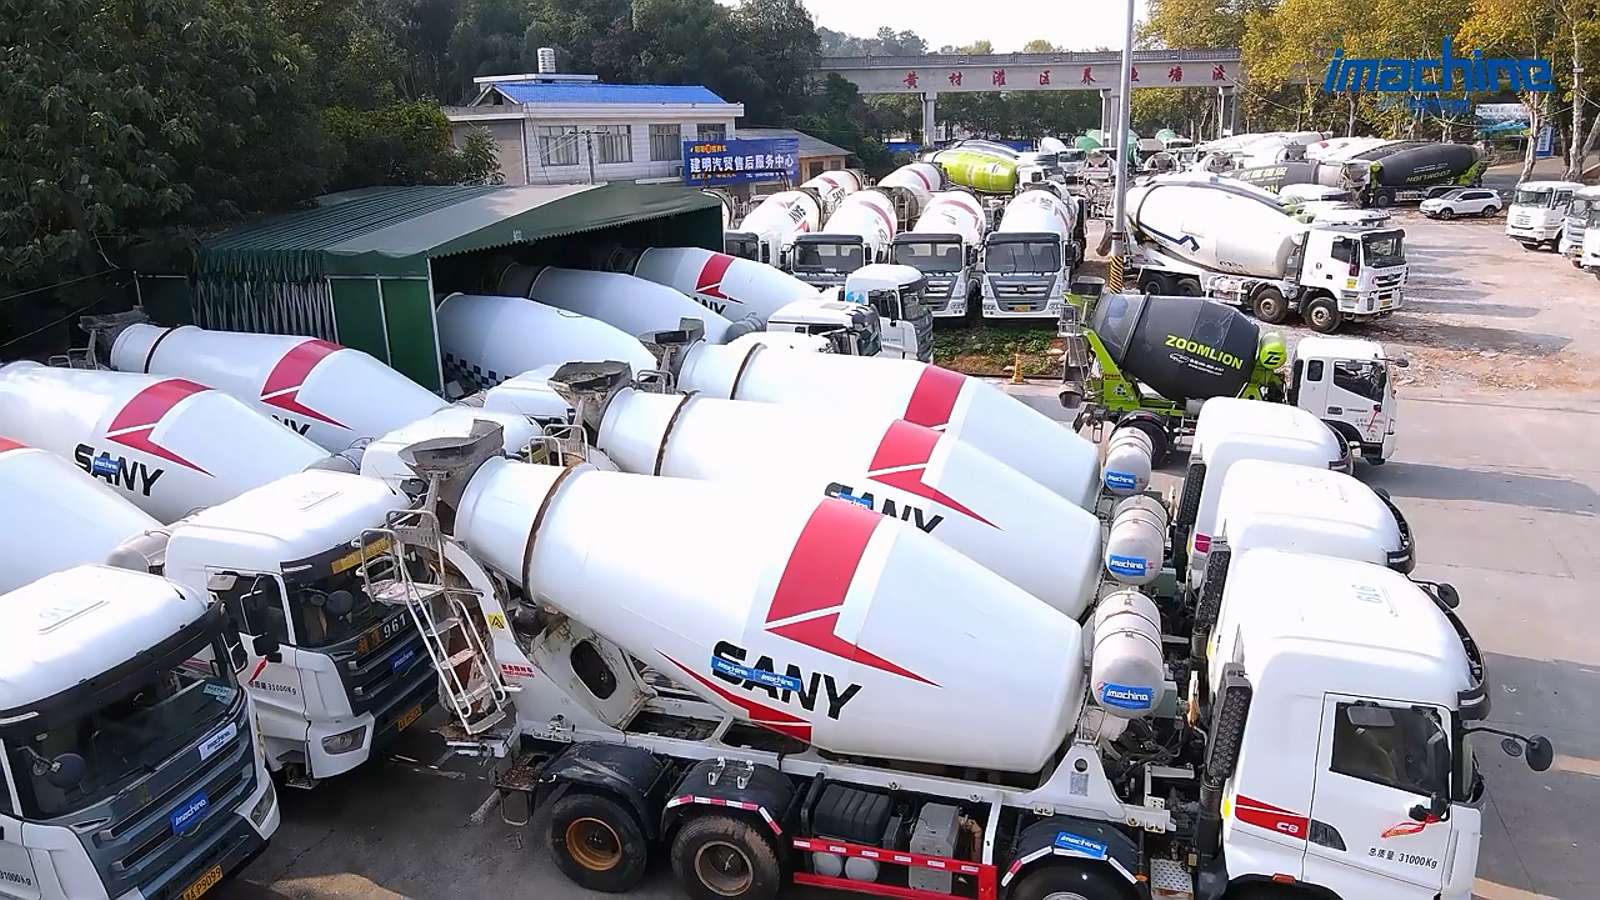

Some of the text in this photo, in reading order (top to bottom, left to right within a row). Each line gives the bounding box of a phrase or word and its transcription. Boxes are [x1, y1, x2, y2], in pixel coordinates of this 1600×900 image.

[690, 154, 795, 173] 建明汽贸售后服务中心
[1164, 334, 1244, 370] ZOOMLION
[383, 613, 406, 638] 961
[1106, 689, 1149, 701] imachine
[1276, 821, 1299, 833] C8
[1368, 847, 1438, 869] 总质量 31000Kg
